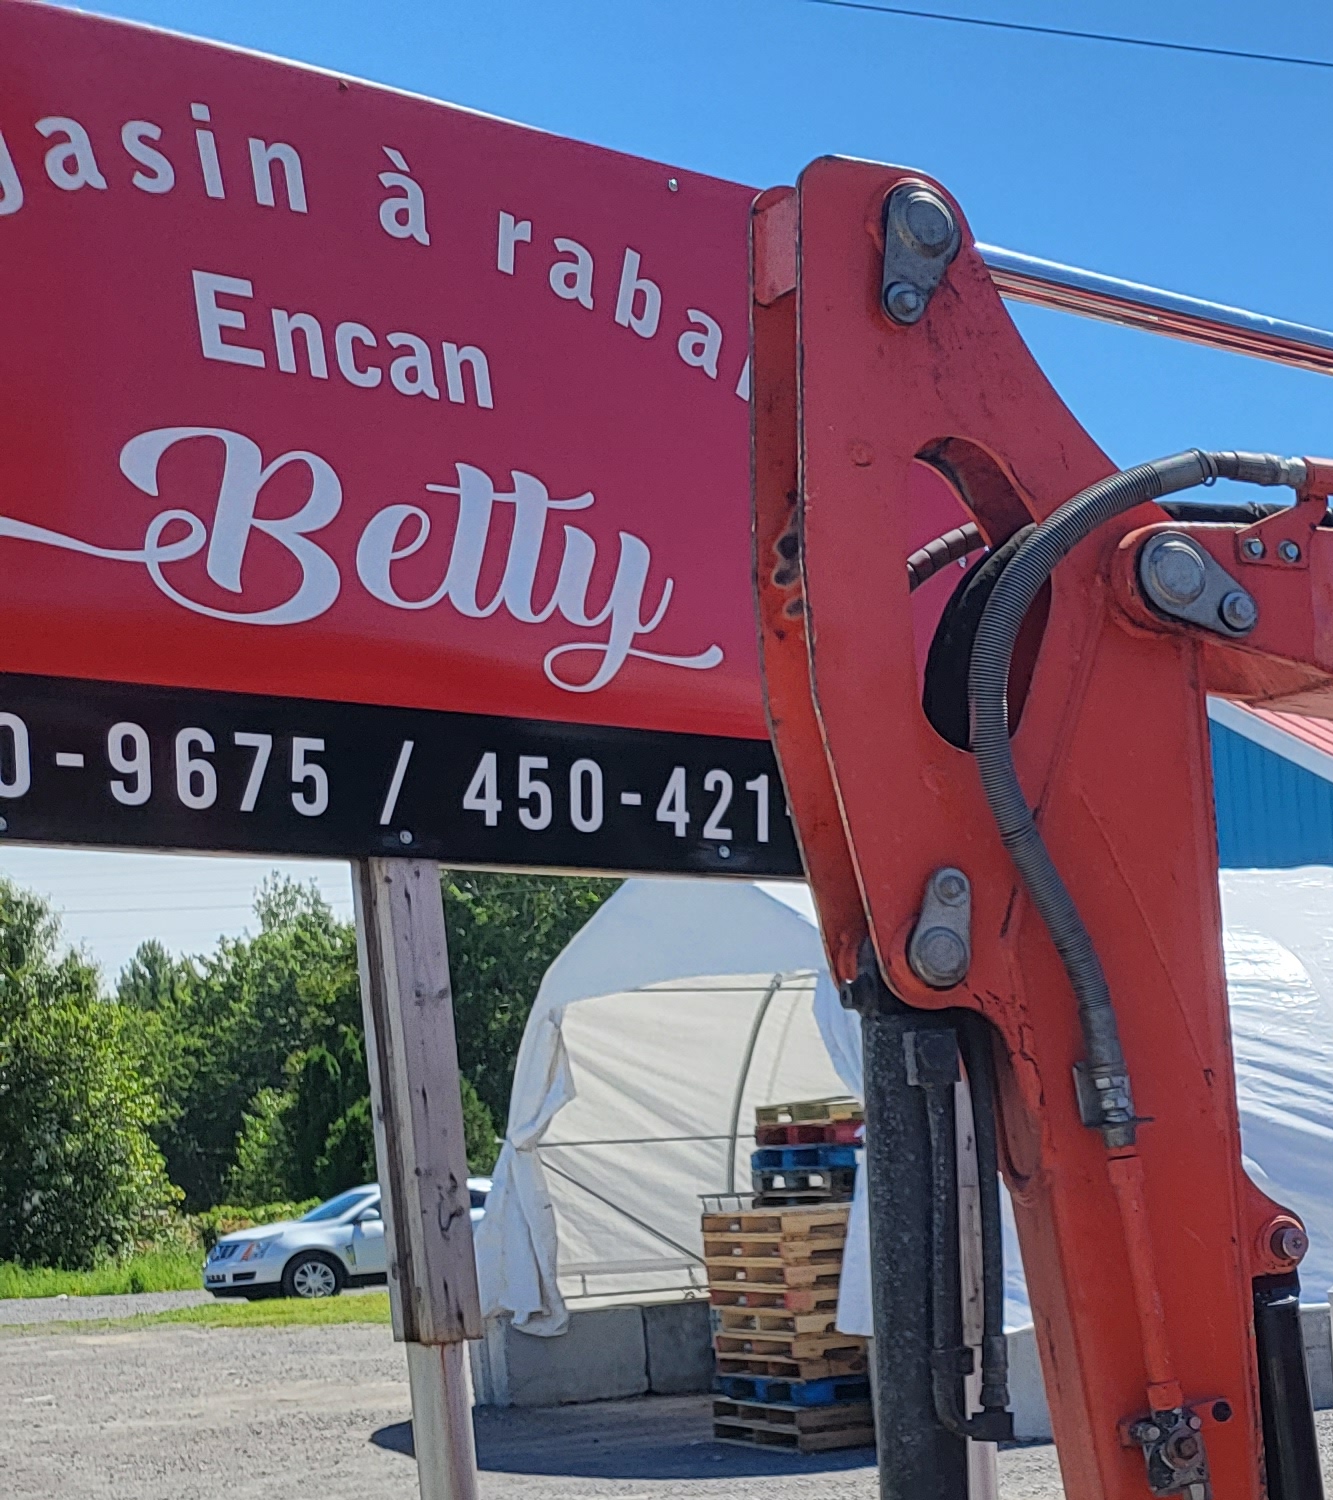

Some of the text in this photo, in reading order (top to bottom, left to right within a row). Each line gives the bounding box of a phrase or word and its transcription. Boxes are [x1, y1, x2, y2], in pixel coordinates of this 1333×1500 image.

[377, 145, 431, 246] à
[191, 269, 495, 410] Encan
[118, 425, 724, 694] Betty
[462, 751, 792, 844] 450-421
